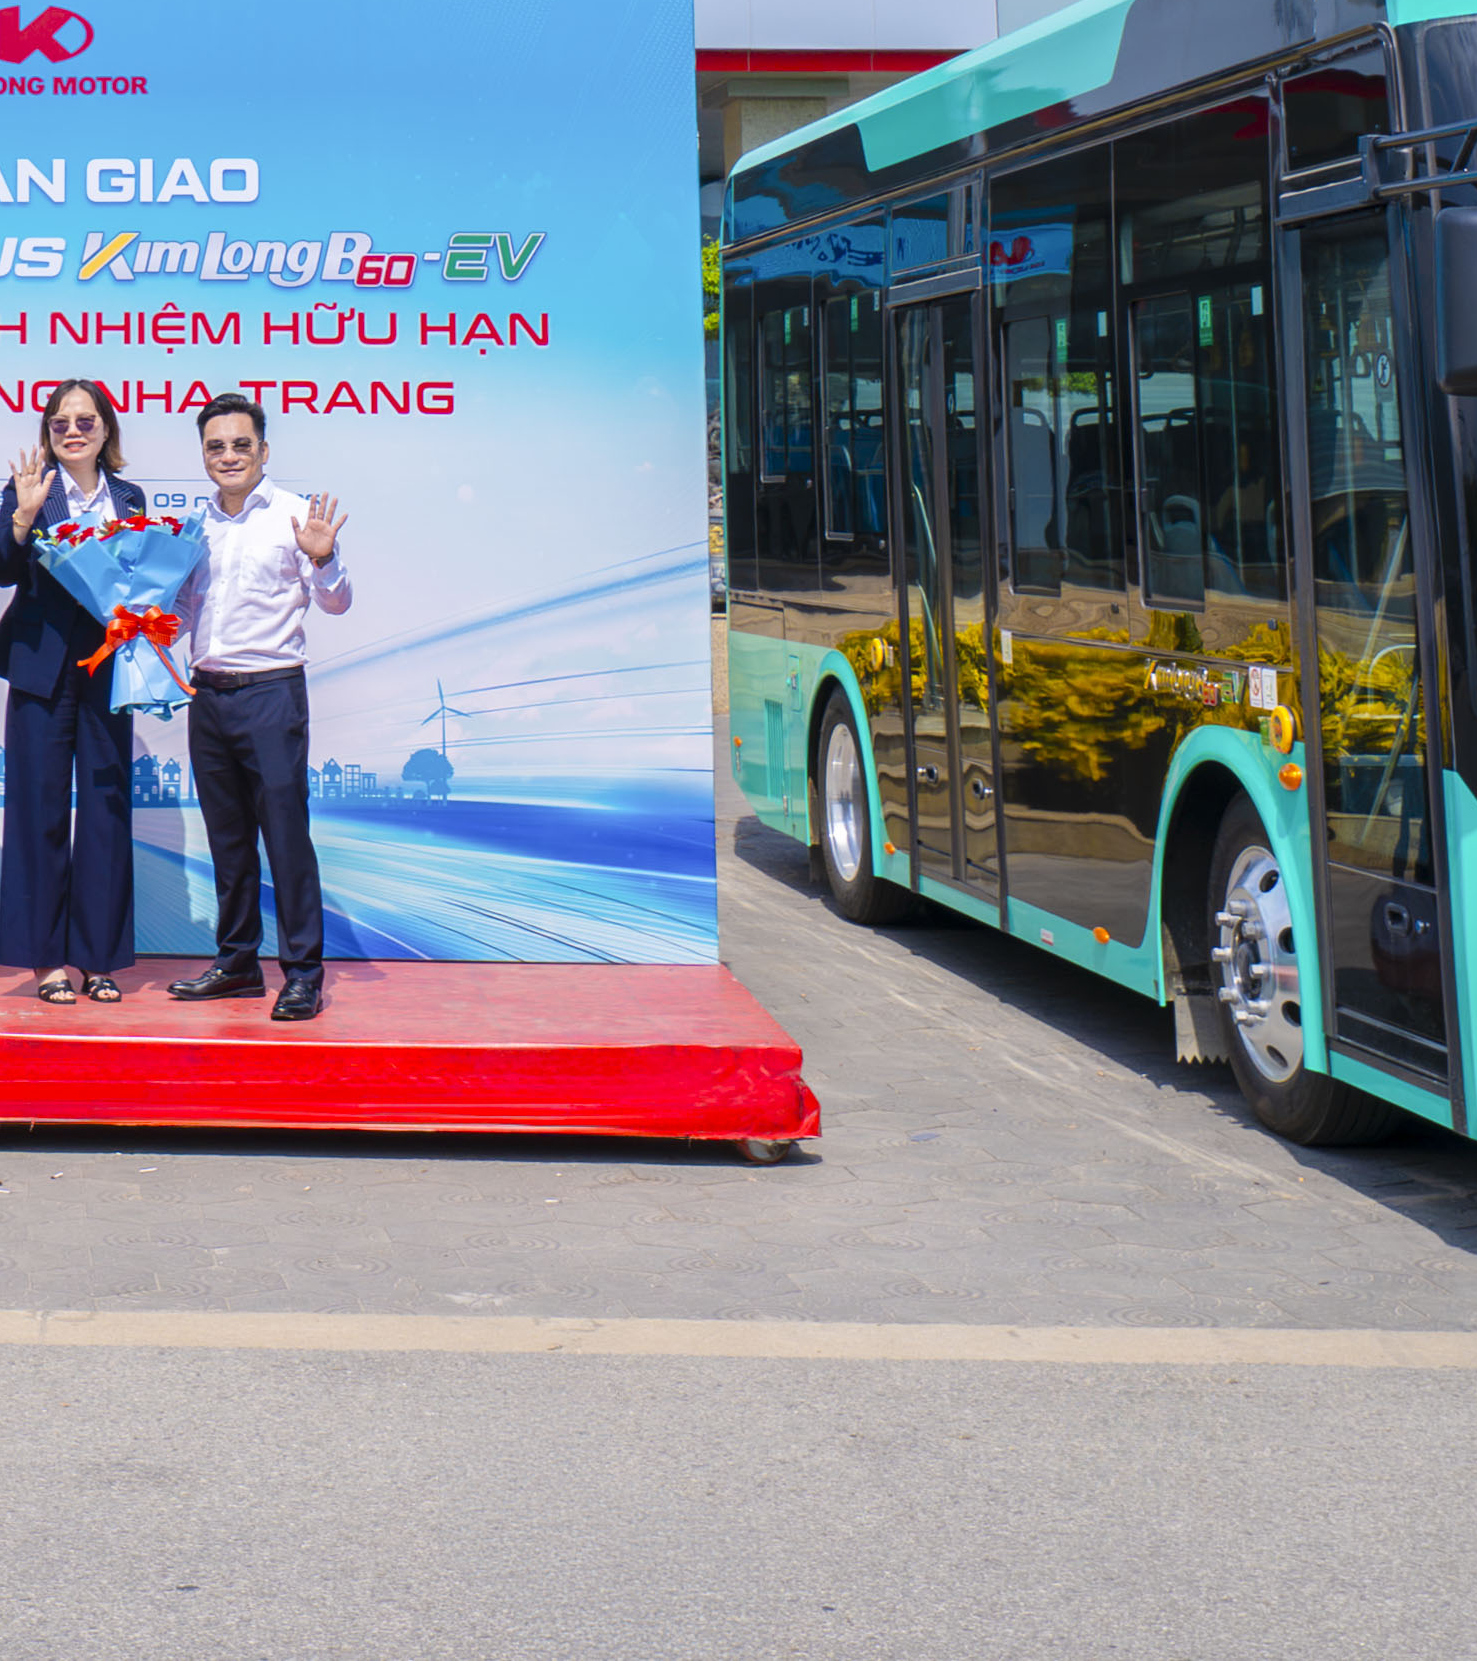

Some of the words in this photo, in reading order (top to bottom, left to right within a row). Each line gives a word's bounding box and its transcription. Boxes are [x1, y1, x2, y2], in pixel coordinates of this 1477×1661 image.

[53, 76, 148, 95] MOTOR
[85, 158, 260, 204] GIAO
[49, 302, 241, 354] NHIỆM
[263, 302, 397, 346] HỮU
[420, 312, 549, 355] HẠN
[239, 381, 455, 415] TRANG
[153, 493, 187, 508] 09
